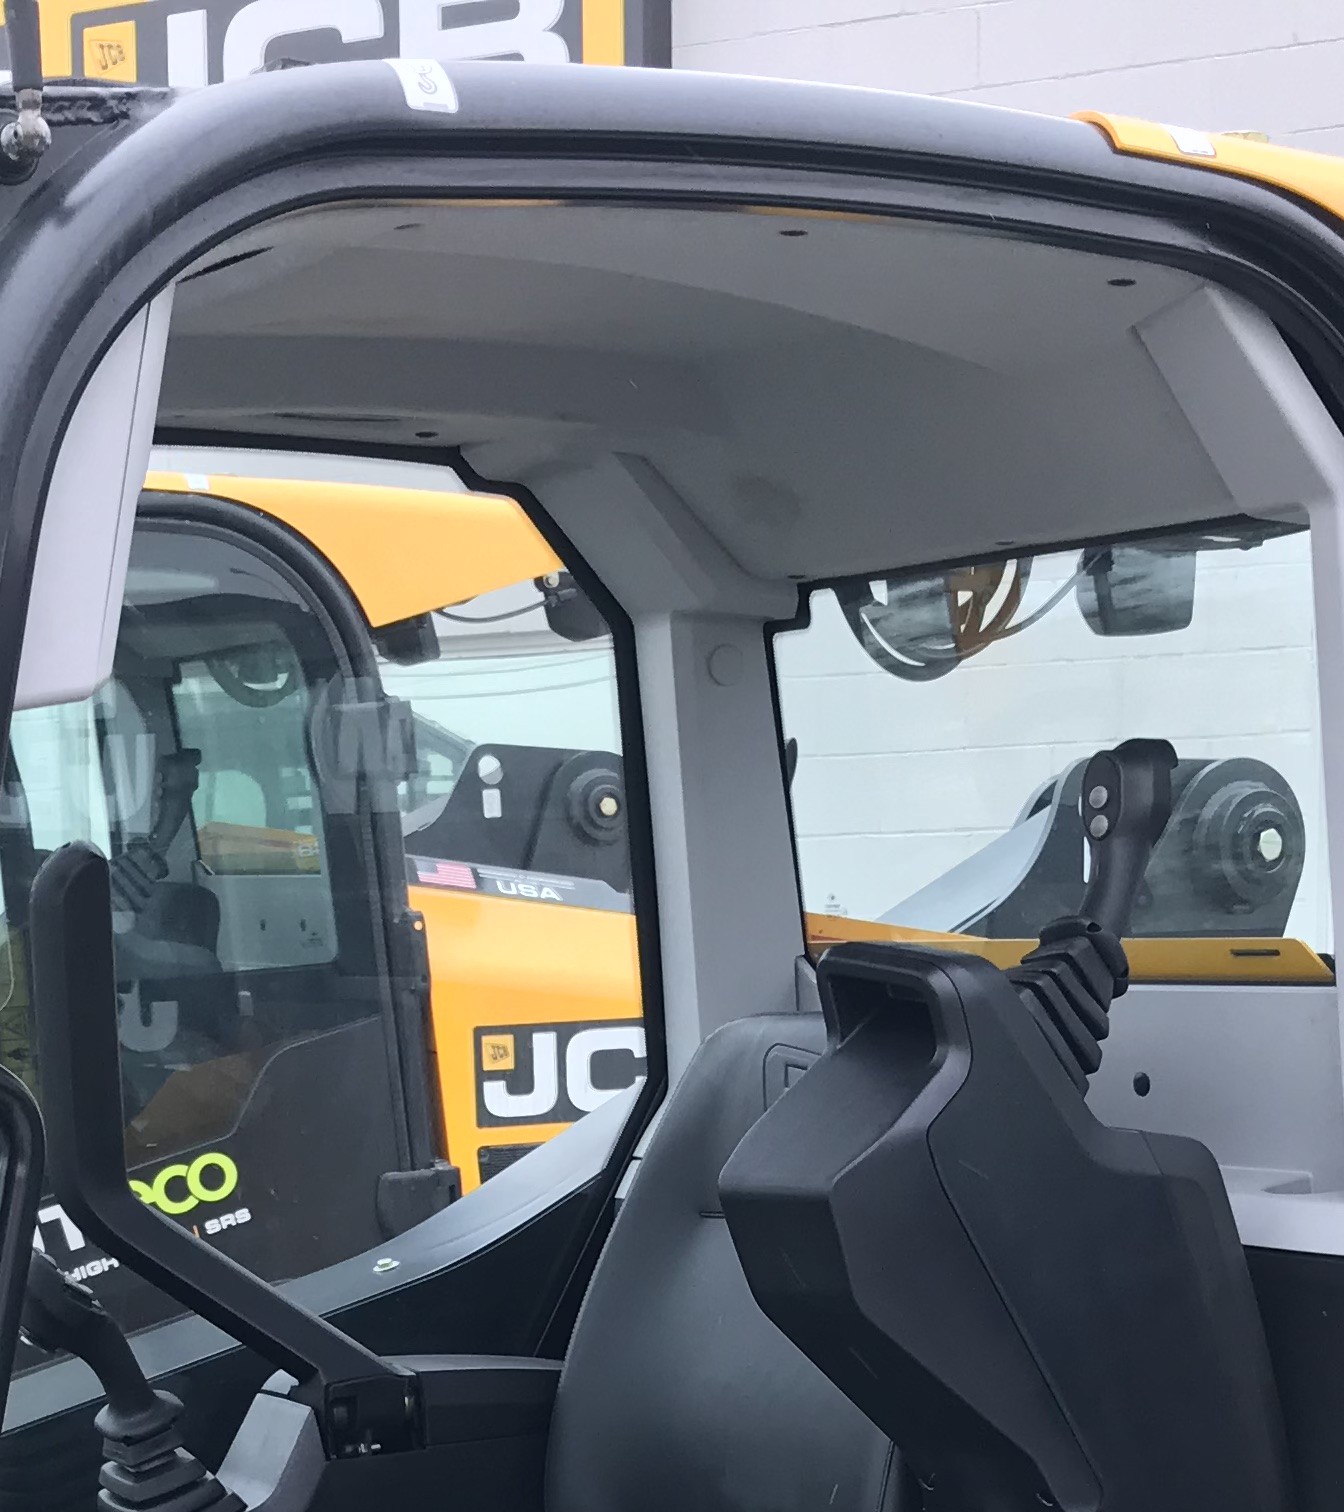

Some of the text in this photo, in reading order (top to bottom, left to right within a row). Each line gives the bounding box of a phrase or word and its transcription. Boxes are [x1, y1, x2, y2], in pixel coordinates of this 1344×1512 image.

[496, 880, 563, 901] USA
[483, 1026, 648, 1118] JC
[204, 1208, 252, 1235] SRS
